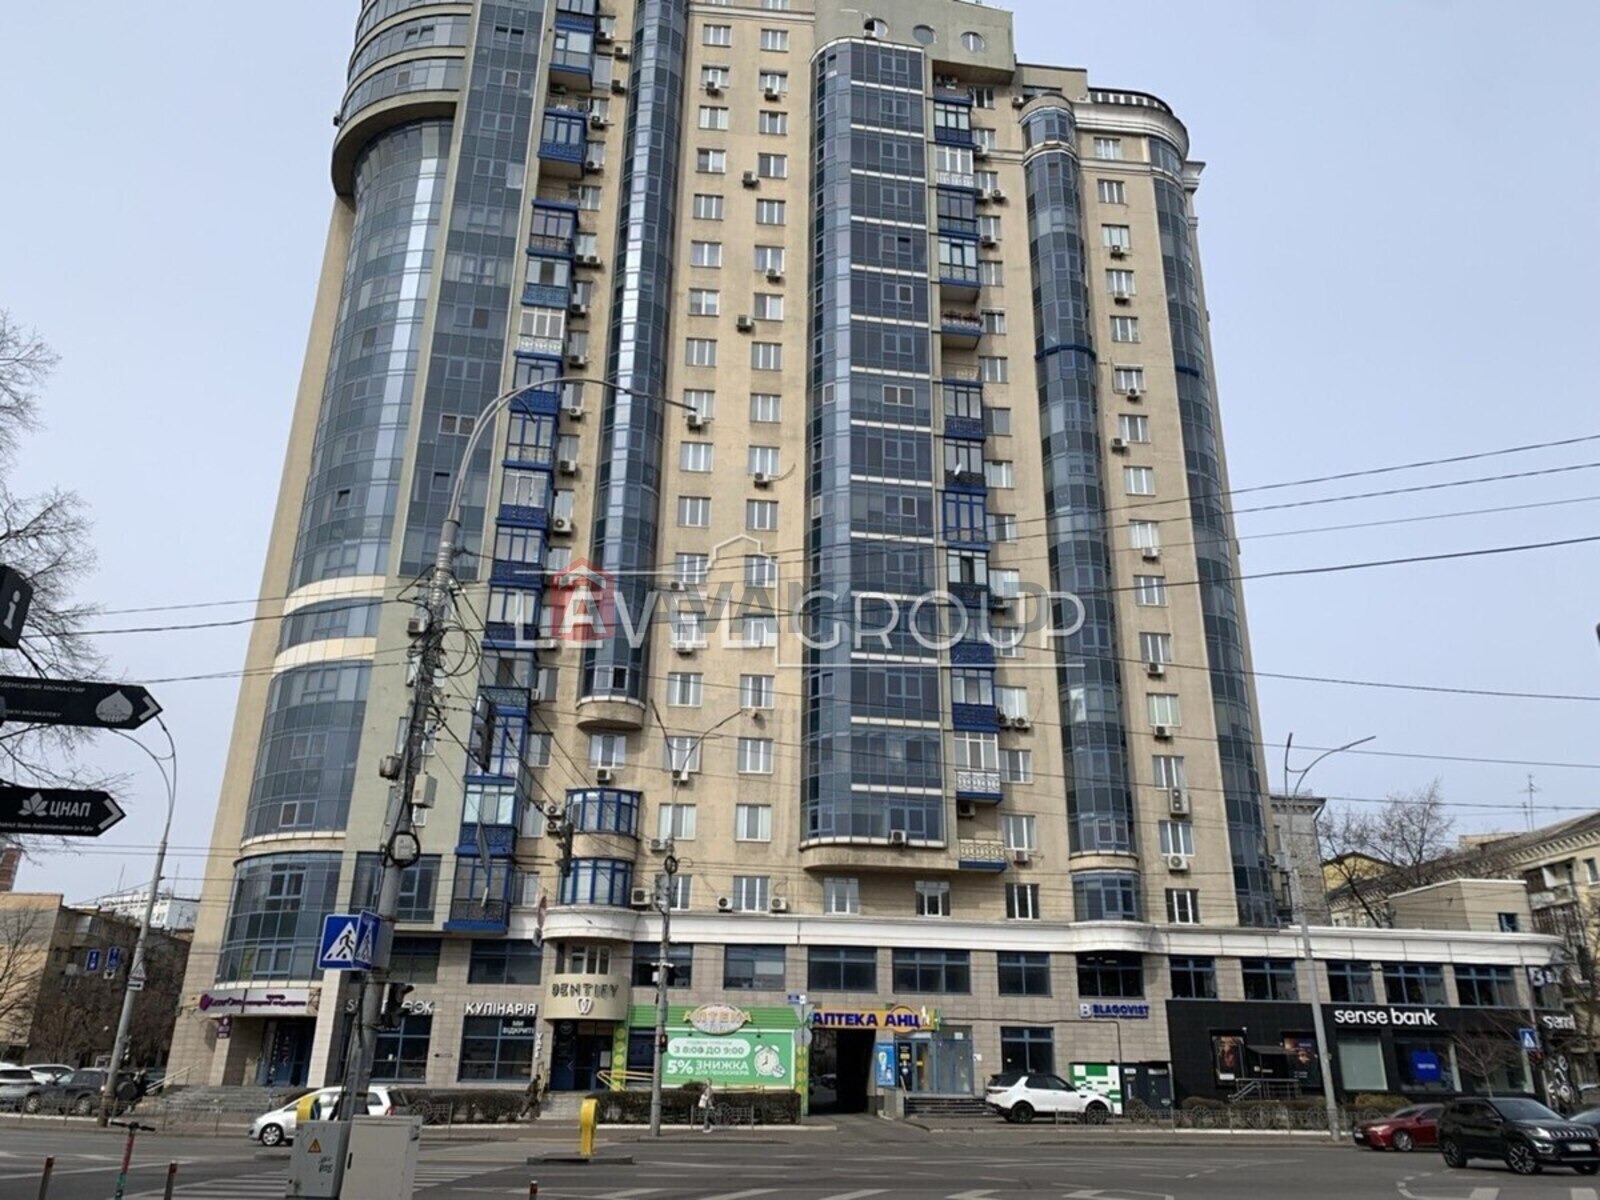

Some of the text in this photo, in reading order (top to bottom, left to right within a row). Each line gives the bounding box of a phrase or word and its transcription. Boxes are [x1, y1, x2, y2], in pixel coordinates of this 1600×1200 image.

[49, 800, 91, 818] ЦНАП
[813, 1012, 921, 1029] АПТЕКА АНЦ
[1334, 1007, 1439, 1026] sense bank
[706, 1046, 721, 1056] ДО
[723, 1046, 744, 1055] 9:00
[666, 1059, 750, 1075] 5% ЗНИЖКА
